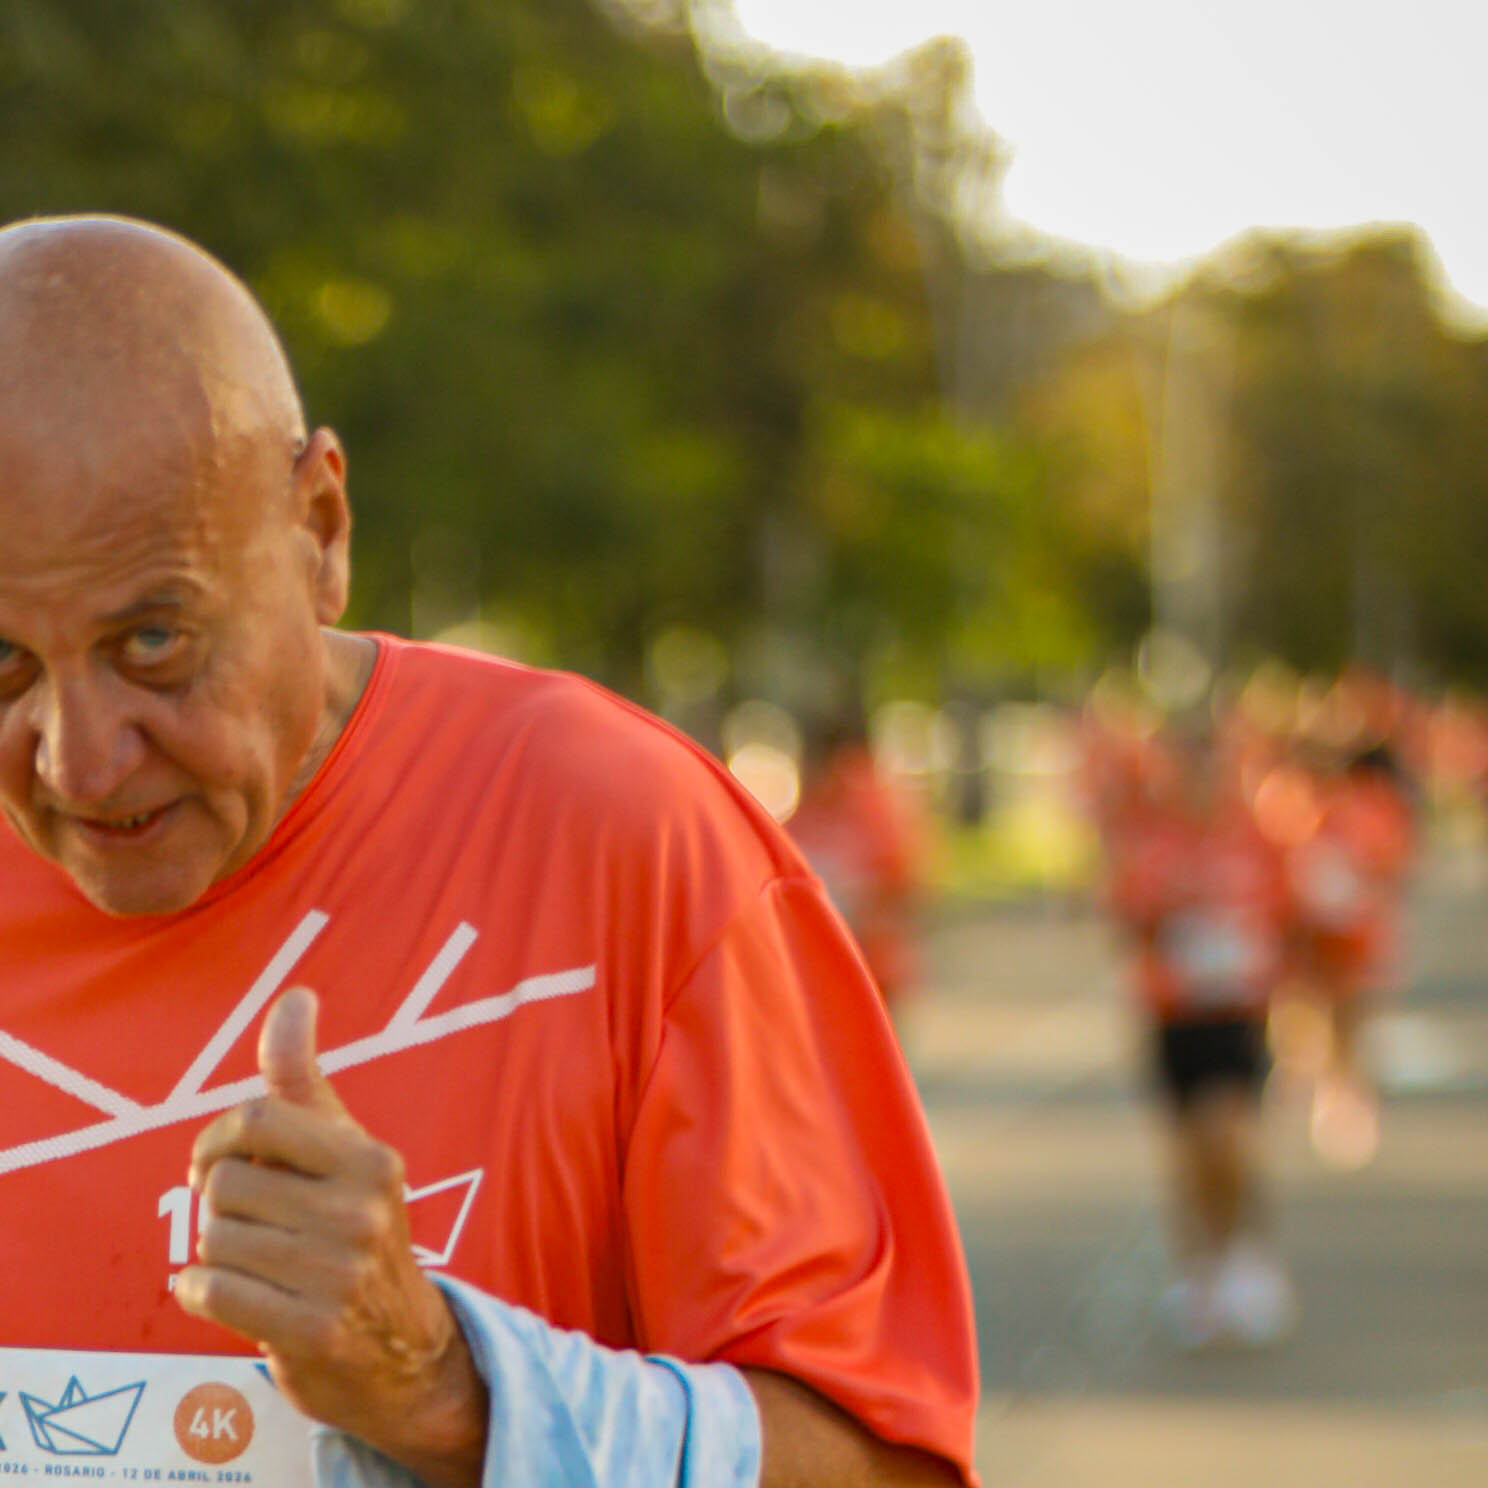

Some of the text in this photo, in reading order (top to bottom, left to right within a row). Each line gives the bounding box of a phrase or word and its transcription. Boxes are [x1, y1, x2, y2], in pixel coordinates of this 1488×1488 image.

[189, 1407, 238, 1440] 4K
[44, 1463, 105, 1478] ROSARIO
[122, 1468, 138, 1480] 12
[144, 1469, 162, 1481] DE
[167, 1469, 210, 1483] ABRIL
